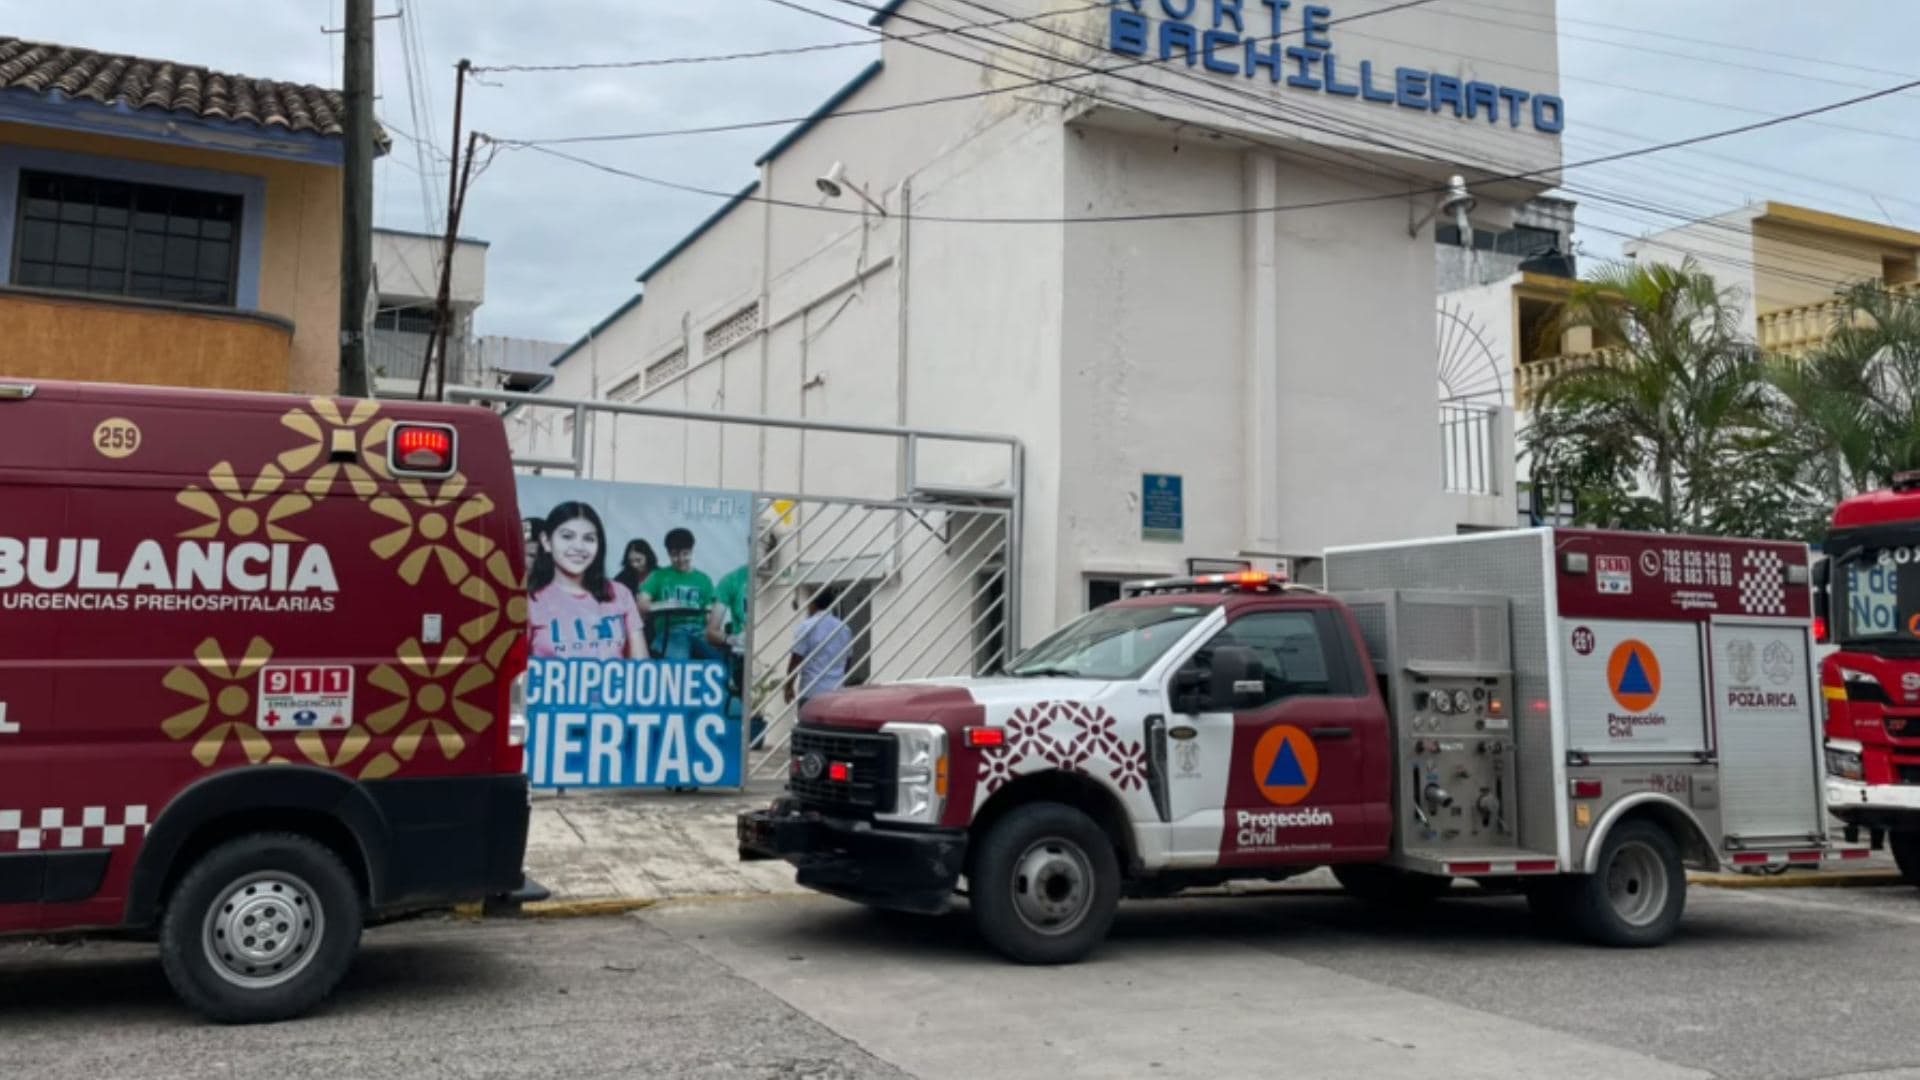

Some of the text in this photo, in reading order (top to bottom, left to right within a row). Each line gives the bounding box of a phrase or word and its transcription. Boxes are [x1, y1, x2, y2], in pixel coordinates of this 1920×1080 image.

[1111, 0, 1331, 49] RTE
[1110, 8, 1564, 134] BACHILLERATO
[99, 426, 136, 449] 259
[1662, 549, 1680, 566] 782
[4, 593, 336, 612] URGENCIAS PREHOSPITALARIAS
[526, 660, 723, 707] CRIPCIONES
[1608, 713, 1666, 726] Protección
[1608, 726, 1633, 738] Civil
[525, 712, 726, 784] IERTAS
[1236, 808, 1333, 828] Protección
[1236, 827, 1276, 846] Civil
